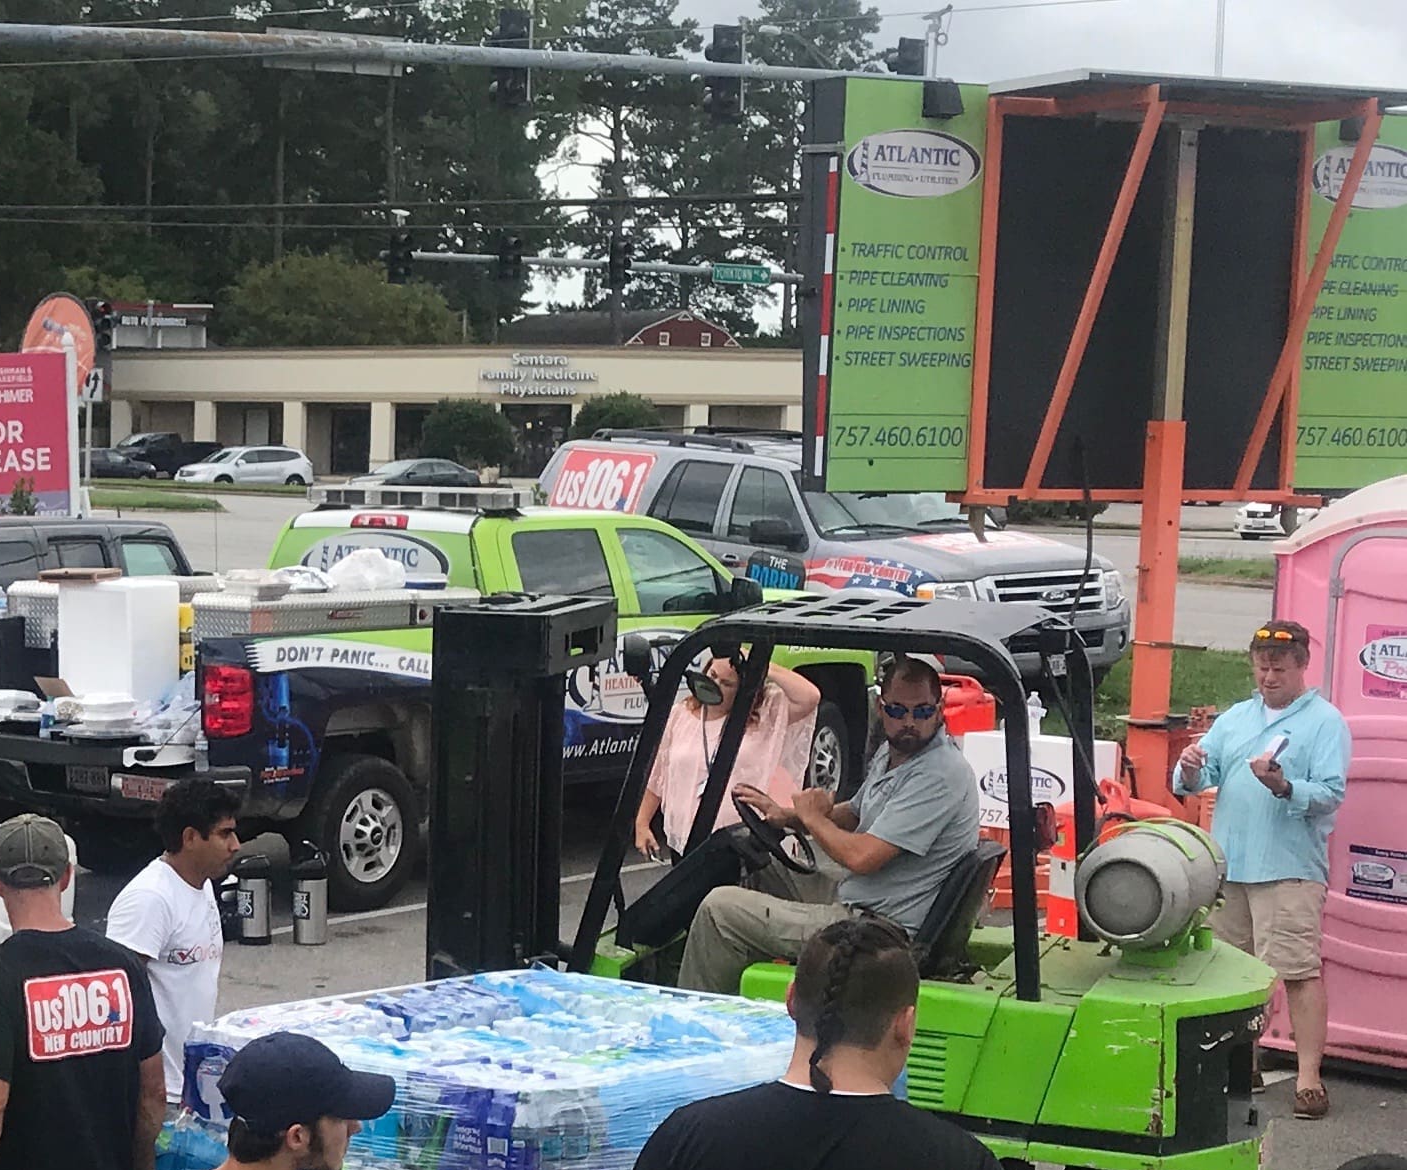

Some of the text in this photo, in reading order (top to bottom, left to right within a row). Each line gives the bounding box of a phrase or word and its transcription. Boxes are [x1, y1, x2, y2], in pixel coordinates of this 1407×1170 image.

[874, 144, 960, 166] ATLANTIC
[851, 243, 969, 262] TRAFFIC CONTROL
[1361, 255, 1407, 273] CONTRO
[848, 271, 949, 288] PIPE CLEANING
[1338, 281, 1399, 297] CLEANING
[847, 298, 926, 314] PIPE LINING
[1337, 307, 1377, 322] LINING
[845, 325, 965, 341] PIPE INSPECTIONS
[1306, 331, 1332, 346] PIPE
[512, 353, 568, 366] Sentara
[844, 351, 971, 368] STREET SWEEPING
[1305, 355, 1407, 372] STREET SWEEPIN
[480, 368, 598, 382] Family Medicine
[500, 382, 577, 398] Physicians
[834, 426, 964, 447] 757.460.6100
[769, 555, 789, 570] THE
[276, 646, 430, 674] DON'T PANIC... CALL
[44, 1025, 124, 1053] NEW COUNTRY
